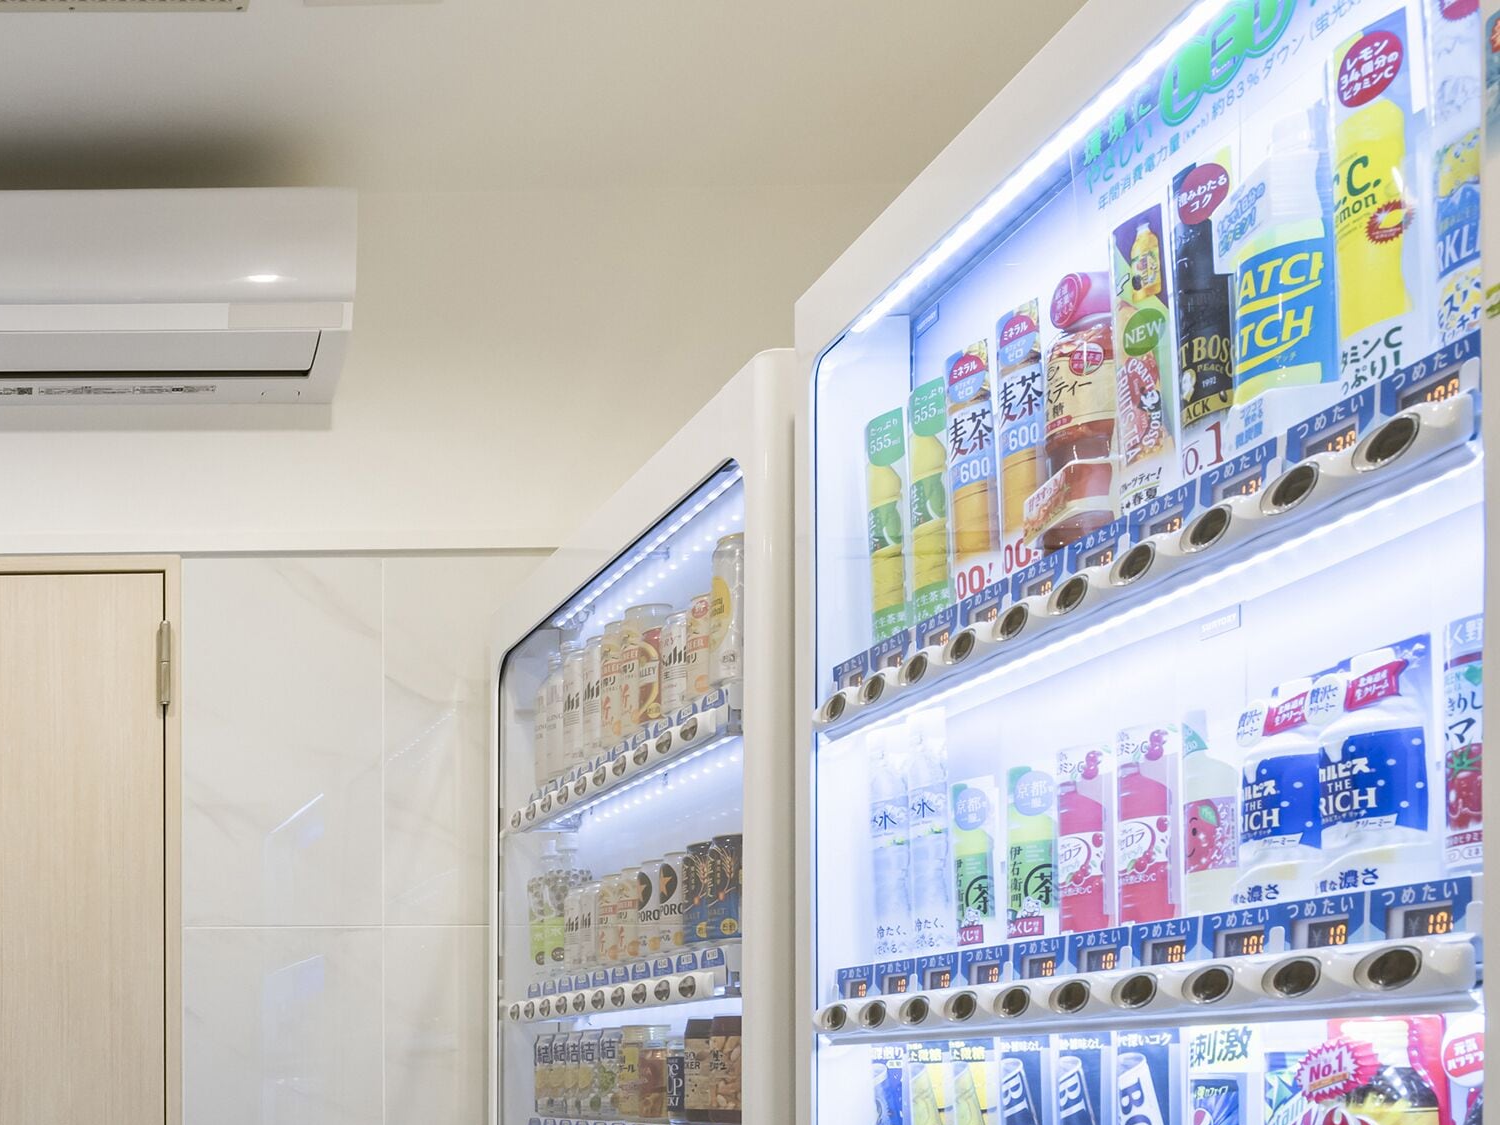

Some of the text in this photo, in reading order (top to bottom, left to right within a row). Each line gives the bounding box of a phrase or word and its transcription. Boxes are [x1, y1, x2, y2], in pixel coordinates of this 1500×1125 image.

[1345, 39, 1389, 71] レモン
[1340, 52, 1399, 90] 34個分の
[1342, 65, 1394, 101] ビタミンC
[1333, 155, 1382, 213] .C.
[1189, 192, 1213, 214] コク
[1003, 321, 1029, 341] ミネラル
[1124, 317, 1164, 350] NEW
[1235, 306, 1315, 358] TCH
[952, 361, 978, 380] ミネラル
[1392, 339, 1470, 390] つめたい
[1127, 357, 1162, 449] CRAFT BOSS
[1297, 393, 1365, 438] つめたい
[1008, 421, 1040, 451] 600
[959, 456, 991, 484] 600
[1209, 445, 1268, 486] つめたい
[1137, 486, 1189, 522] つめたい
[1074, 522, 1120, 555] つめたい
[1017, 554, 1060, 585] つめたい
[1327, 778, 1352, 793] THE
[1010, 846, 1023, 908] 伊右衛門
[1287, 894, 1354, 920] つめたい
[1381, 878, 1460, 907] つめたい
[1139, 920, 1191, 939] つめたい
[1212, 908, 1270, 929] つめたい
[1427, 911, 1454, 935] 10
[1019, 938, 1060, 955] つめたい
[1075, 930, 1121, 948] つめたい
[880, 960, 910, 974] つめたい
[921, 953, 954, 968] つめたい
[966, 947, 1003, 963] つめたい
[1190, 1026, 1253, 1068] 刺激
[1309, 1052, 1345, 1083] No.1
